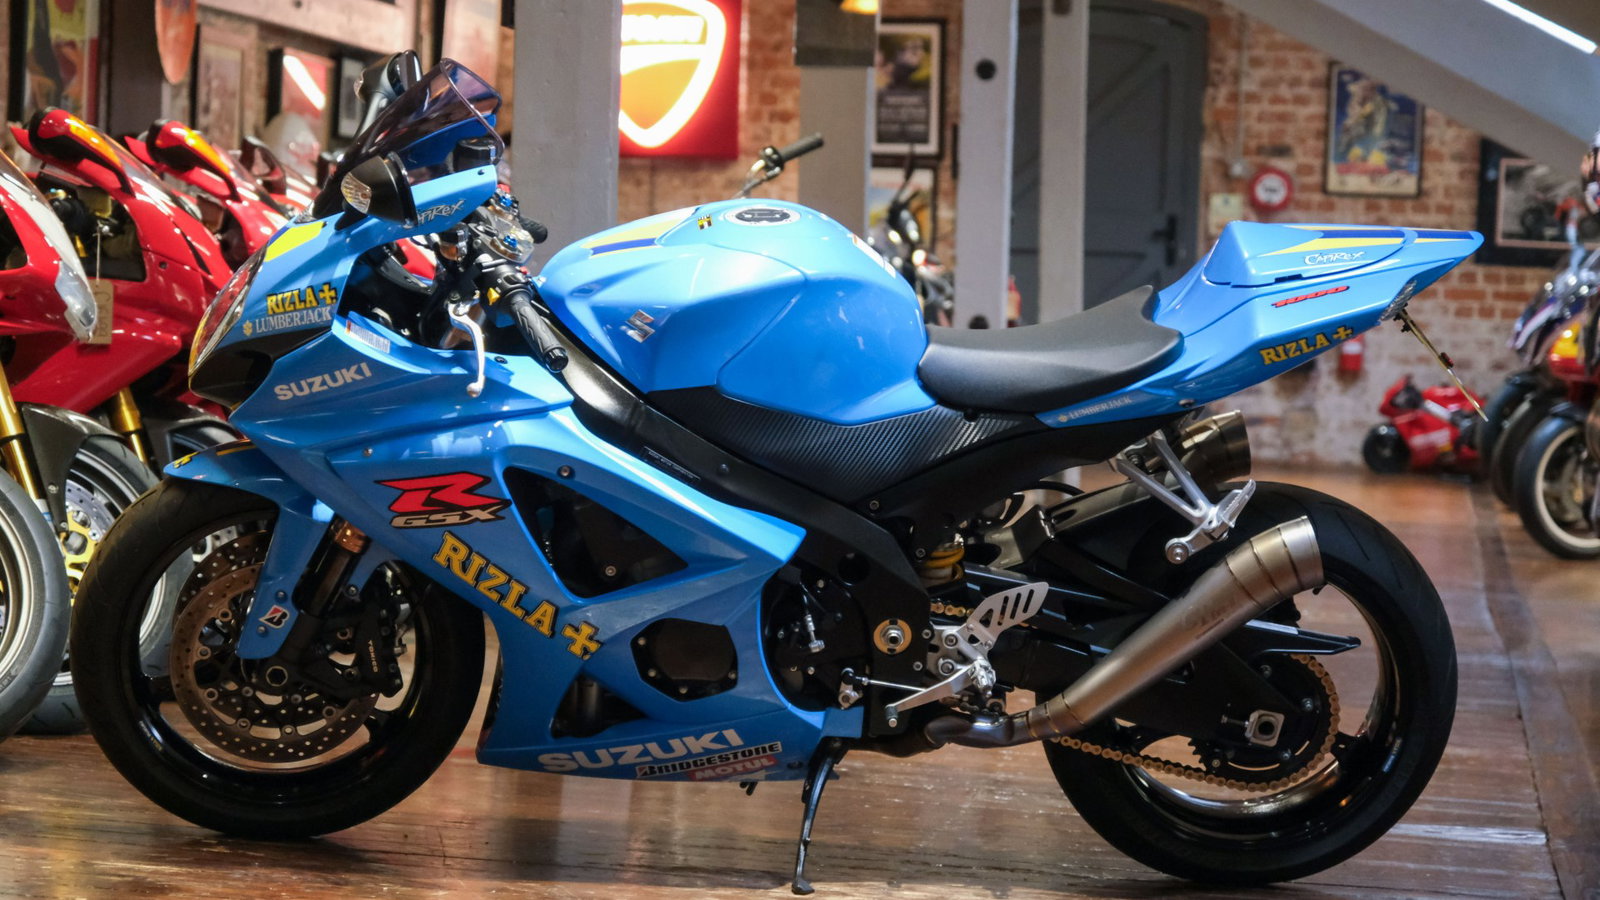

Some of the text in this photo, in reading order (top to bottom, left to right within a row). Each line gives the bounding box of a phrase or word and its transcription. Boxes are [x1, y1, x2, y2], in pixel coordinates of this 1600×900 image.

[1271, 286, 1350, 308] 1000
[255, 306, 332, 334] LUMBERJACK
[273, 362, 374, 401] SUZUKI
[391, 505, 502, 528] GSX
[538, 729, 745, 772] SUZUKI
[636, 741, 782, 777] BRIDGESTONE
[694, 757, 775, 781] MOTUL
